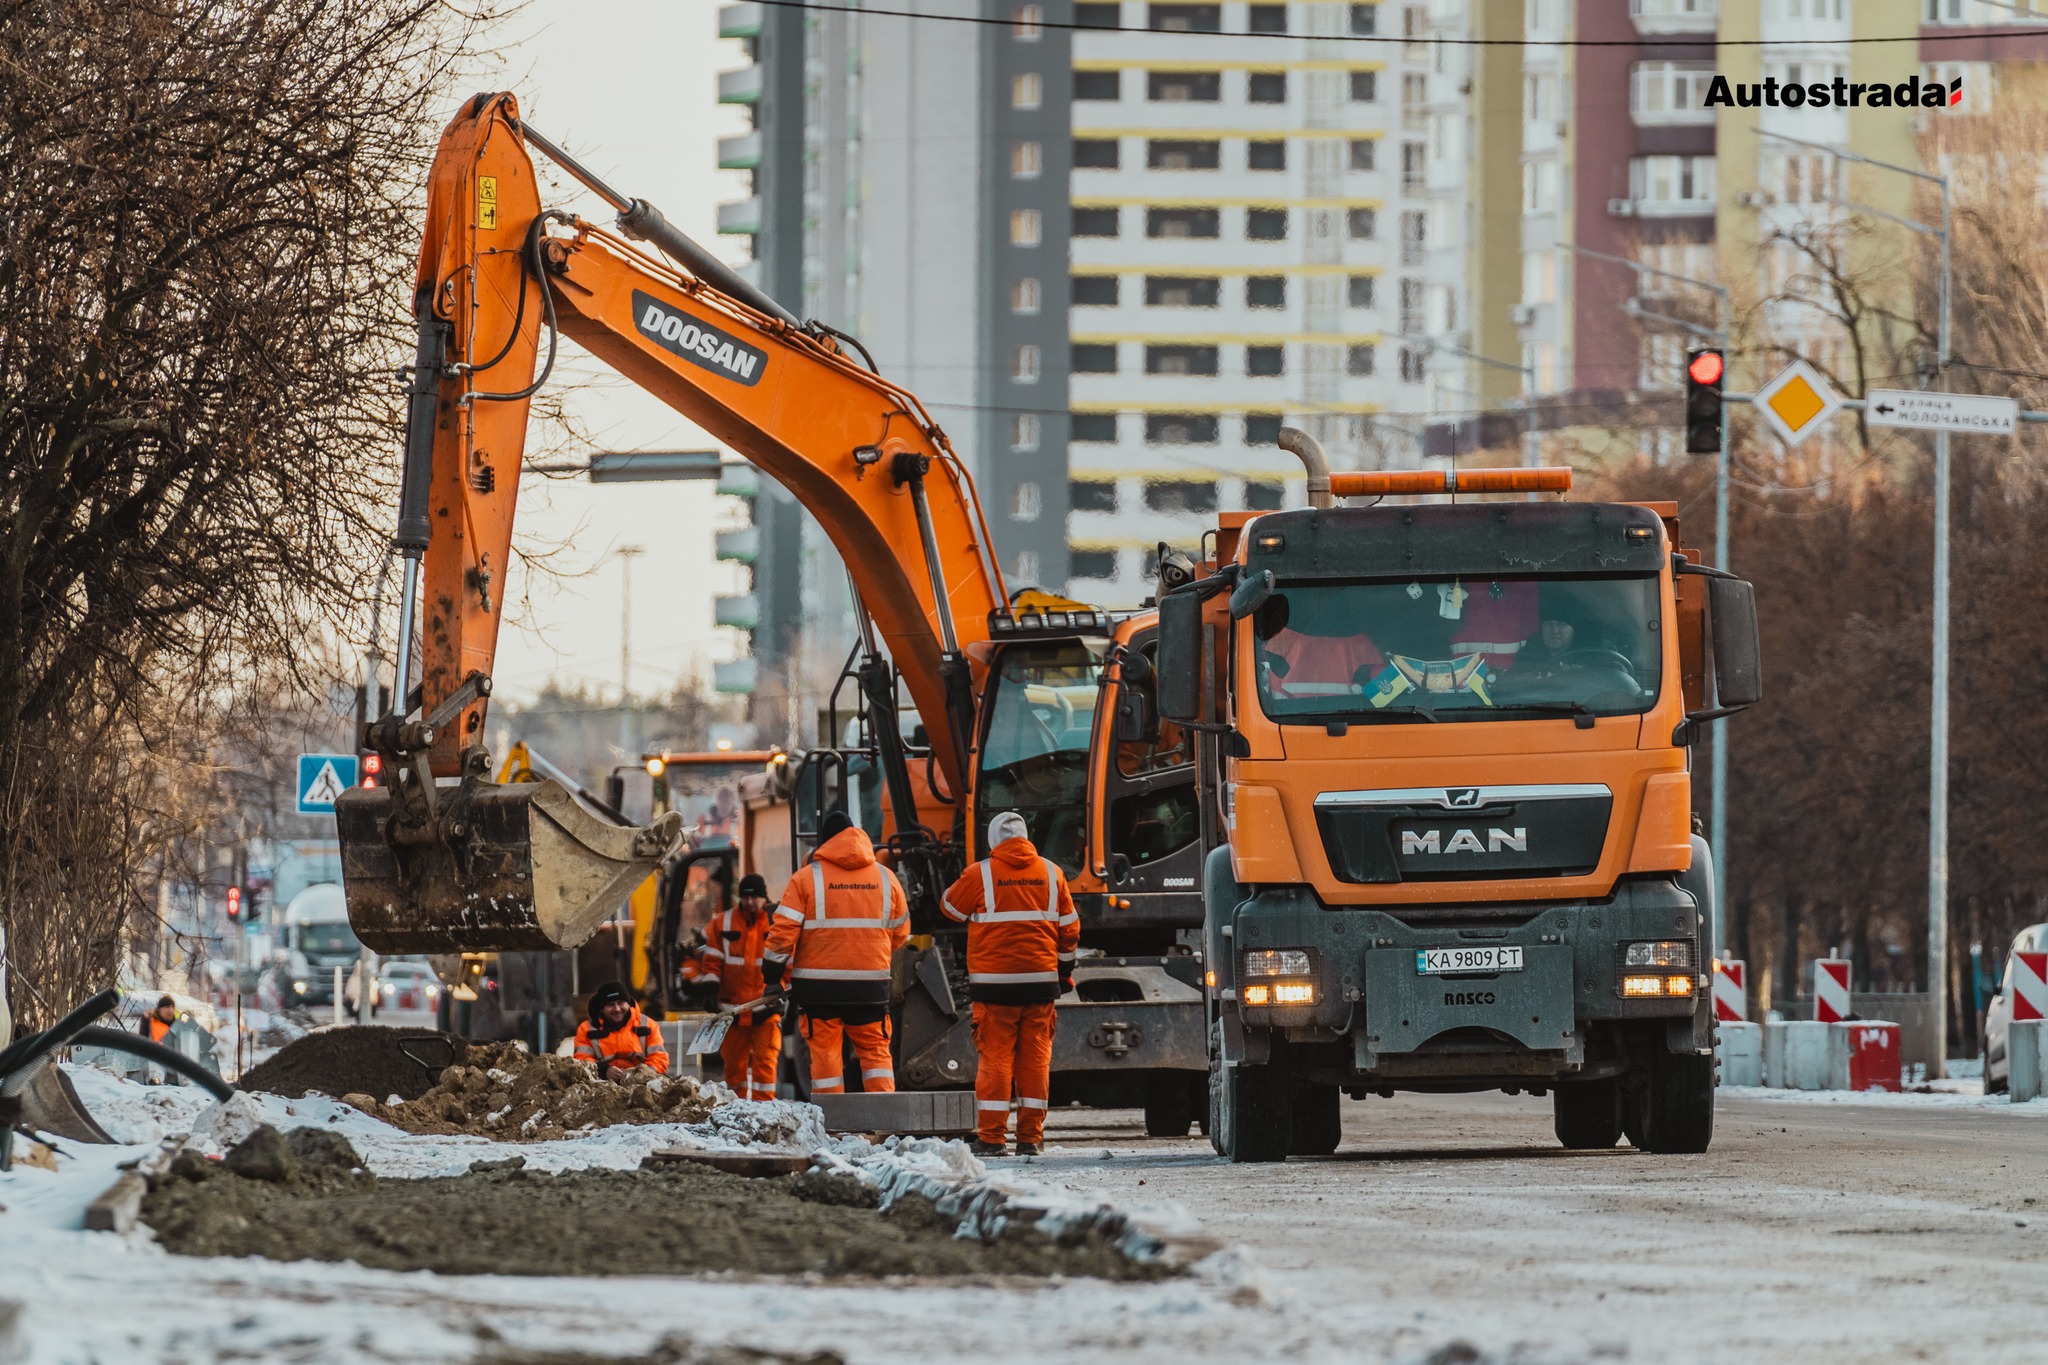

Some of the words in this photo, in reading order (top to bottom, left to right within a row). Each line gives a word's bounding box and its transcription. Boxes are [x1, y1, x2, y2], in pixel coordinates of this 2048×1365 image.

[640, 304, 758, 379] DOOSAN
[1898, 411, 2011, 428] МОЛОЧАНСЬКА
[1401, 827, 1527, 855] MAN
[828, 882, 876, 890] Autostrada
[997, 879, 1044, 887] Autostrada
[1163, 877, 1195, 887] DOOSAN
[1427, 952, 1451, 969] KA
[1454, 950, 1493, 967] 9809
[1496, 949, 1520, 965] CT
[1444, 991, 1496, 1006] RASCO
